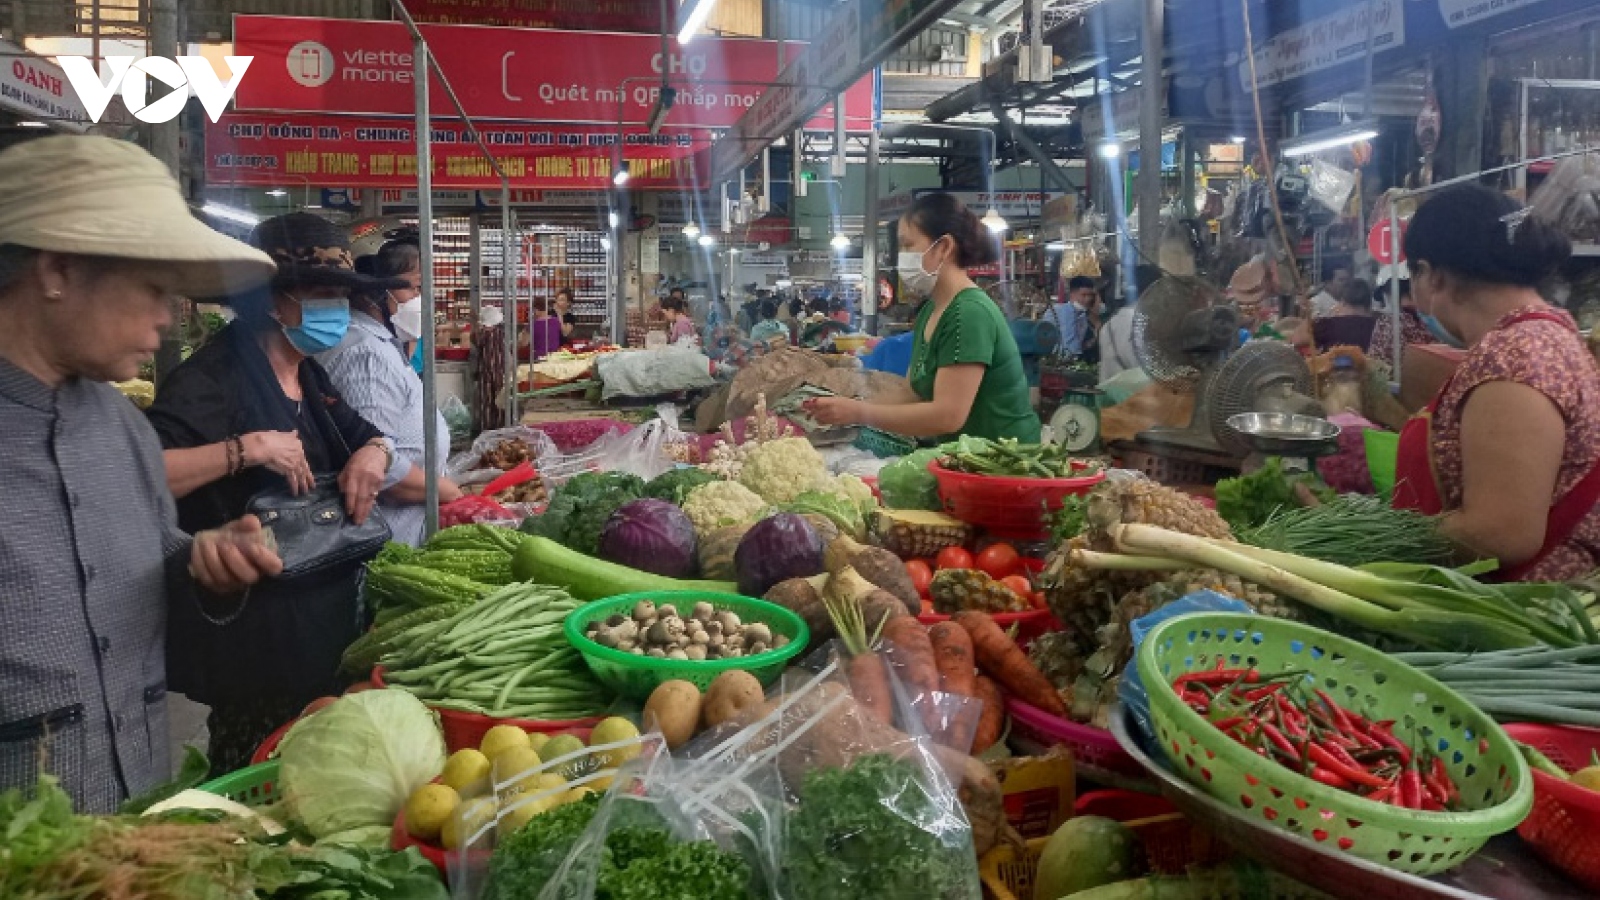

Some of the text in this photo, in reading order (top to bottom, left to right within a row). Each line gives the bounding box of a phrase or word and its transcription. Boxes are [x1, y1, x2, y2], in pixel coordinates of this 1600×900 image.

[344, 49, 413, 66] viette
[651, 52, 706, 80] CHỢ
[12, 58, 64, 97] OANH
[539, 83, 588, 105] Quét
[354, 127, 410, 142] CHUNG
[321, 152, 360, 175] TRANG
